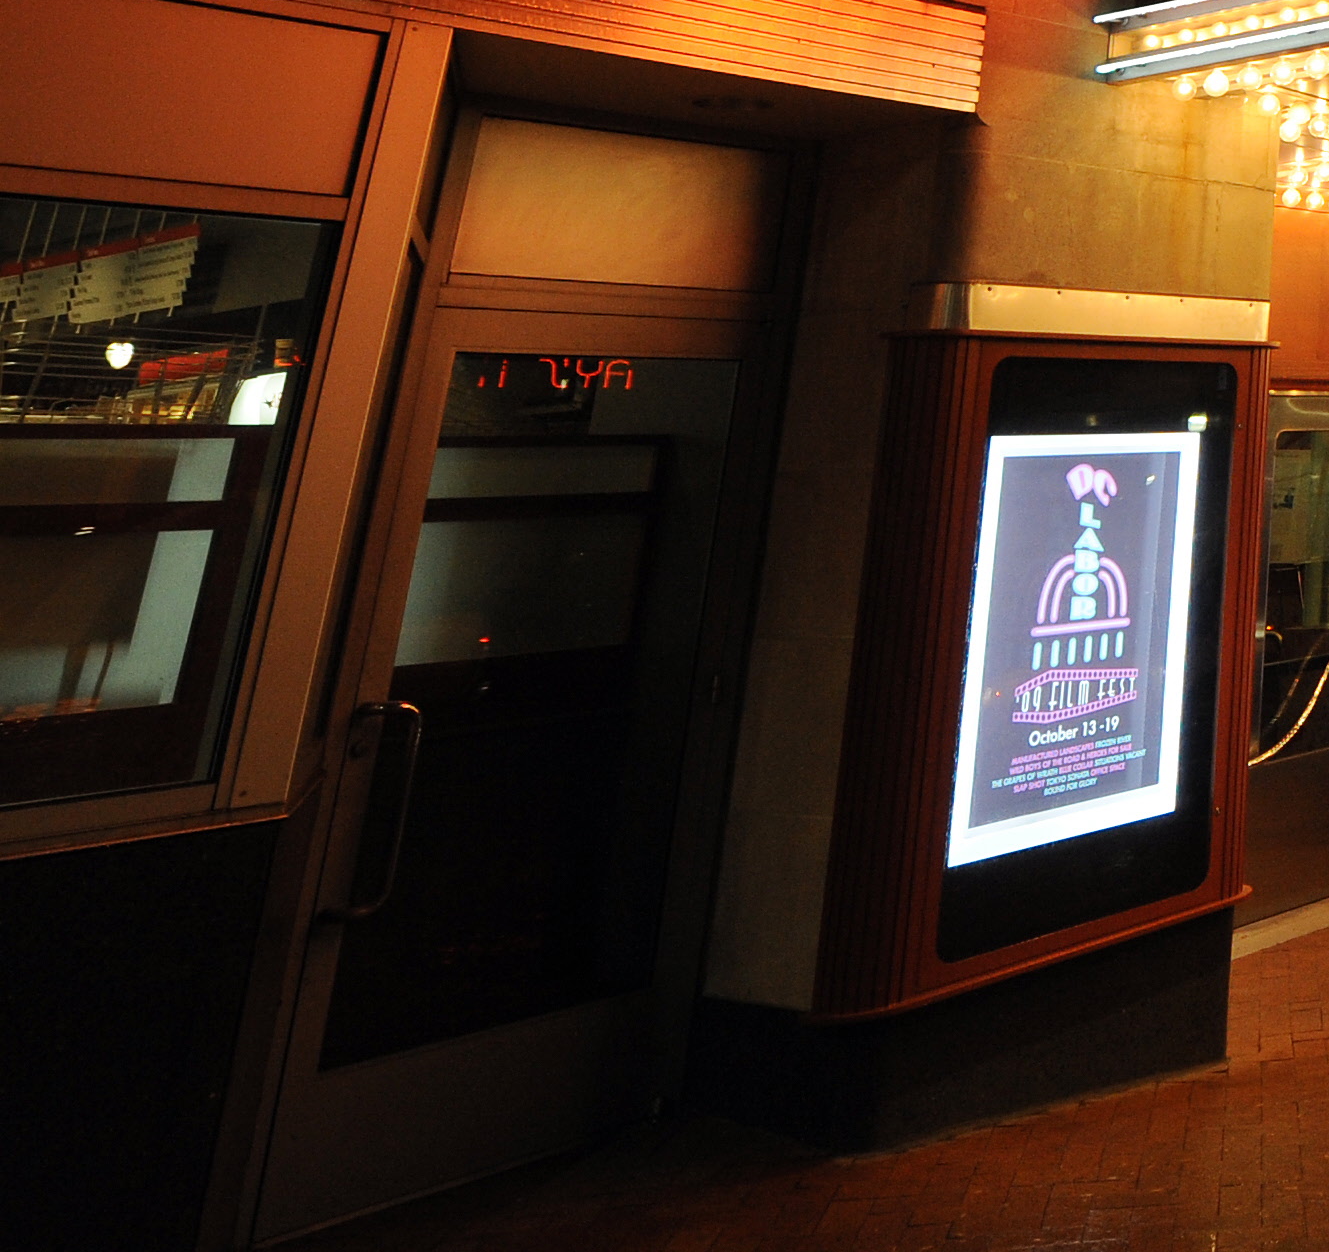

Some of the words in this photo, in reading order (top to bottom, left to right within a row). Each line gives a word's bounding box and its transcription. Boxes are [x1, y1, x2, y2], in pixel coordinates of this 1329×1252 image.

[1066, 463, 1118, 507] DC
[1069, 501, 1105, 621] LABOR
[1048, 680, 1090, 711] FILM
[1097, 676, 1136, 701] FEST
[1028, 724, 1079, 747] October
[1082, 719, 1097, 737] 13
